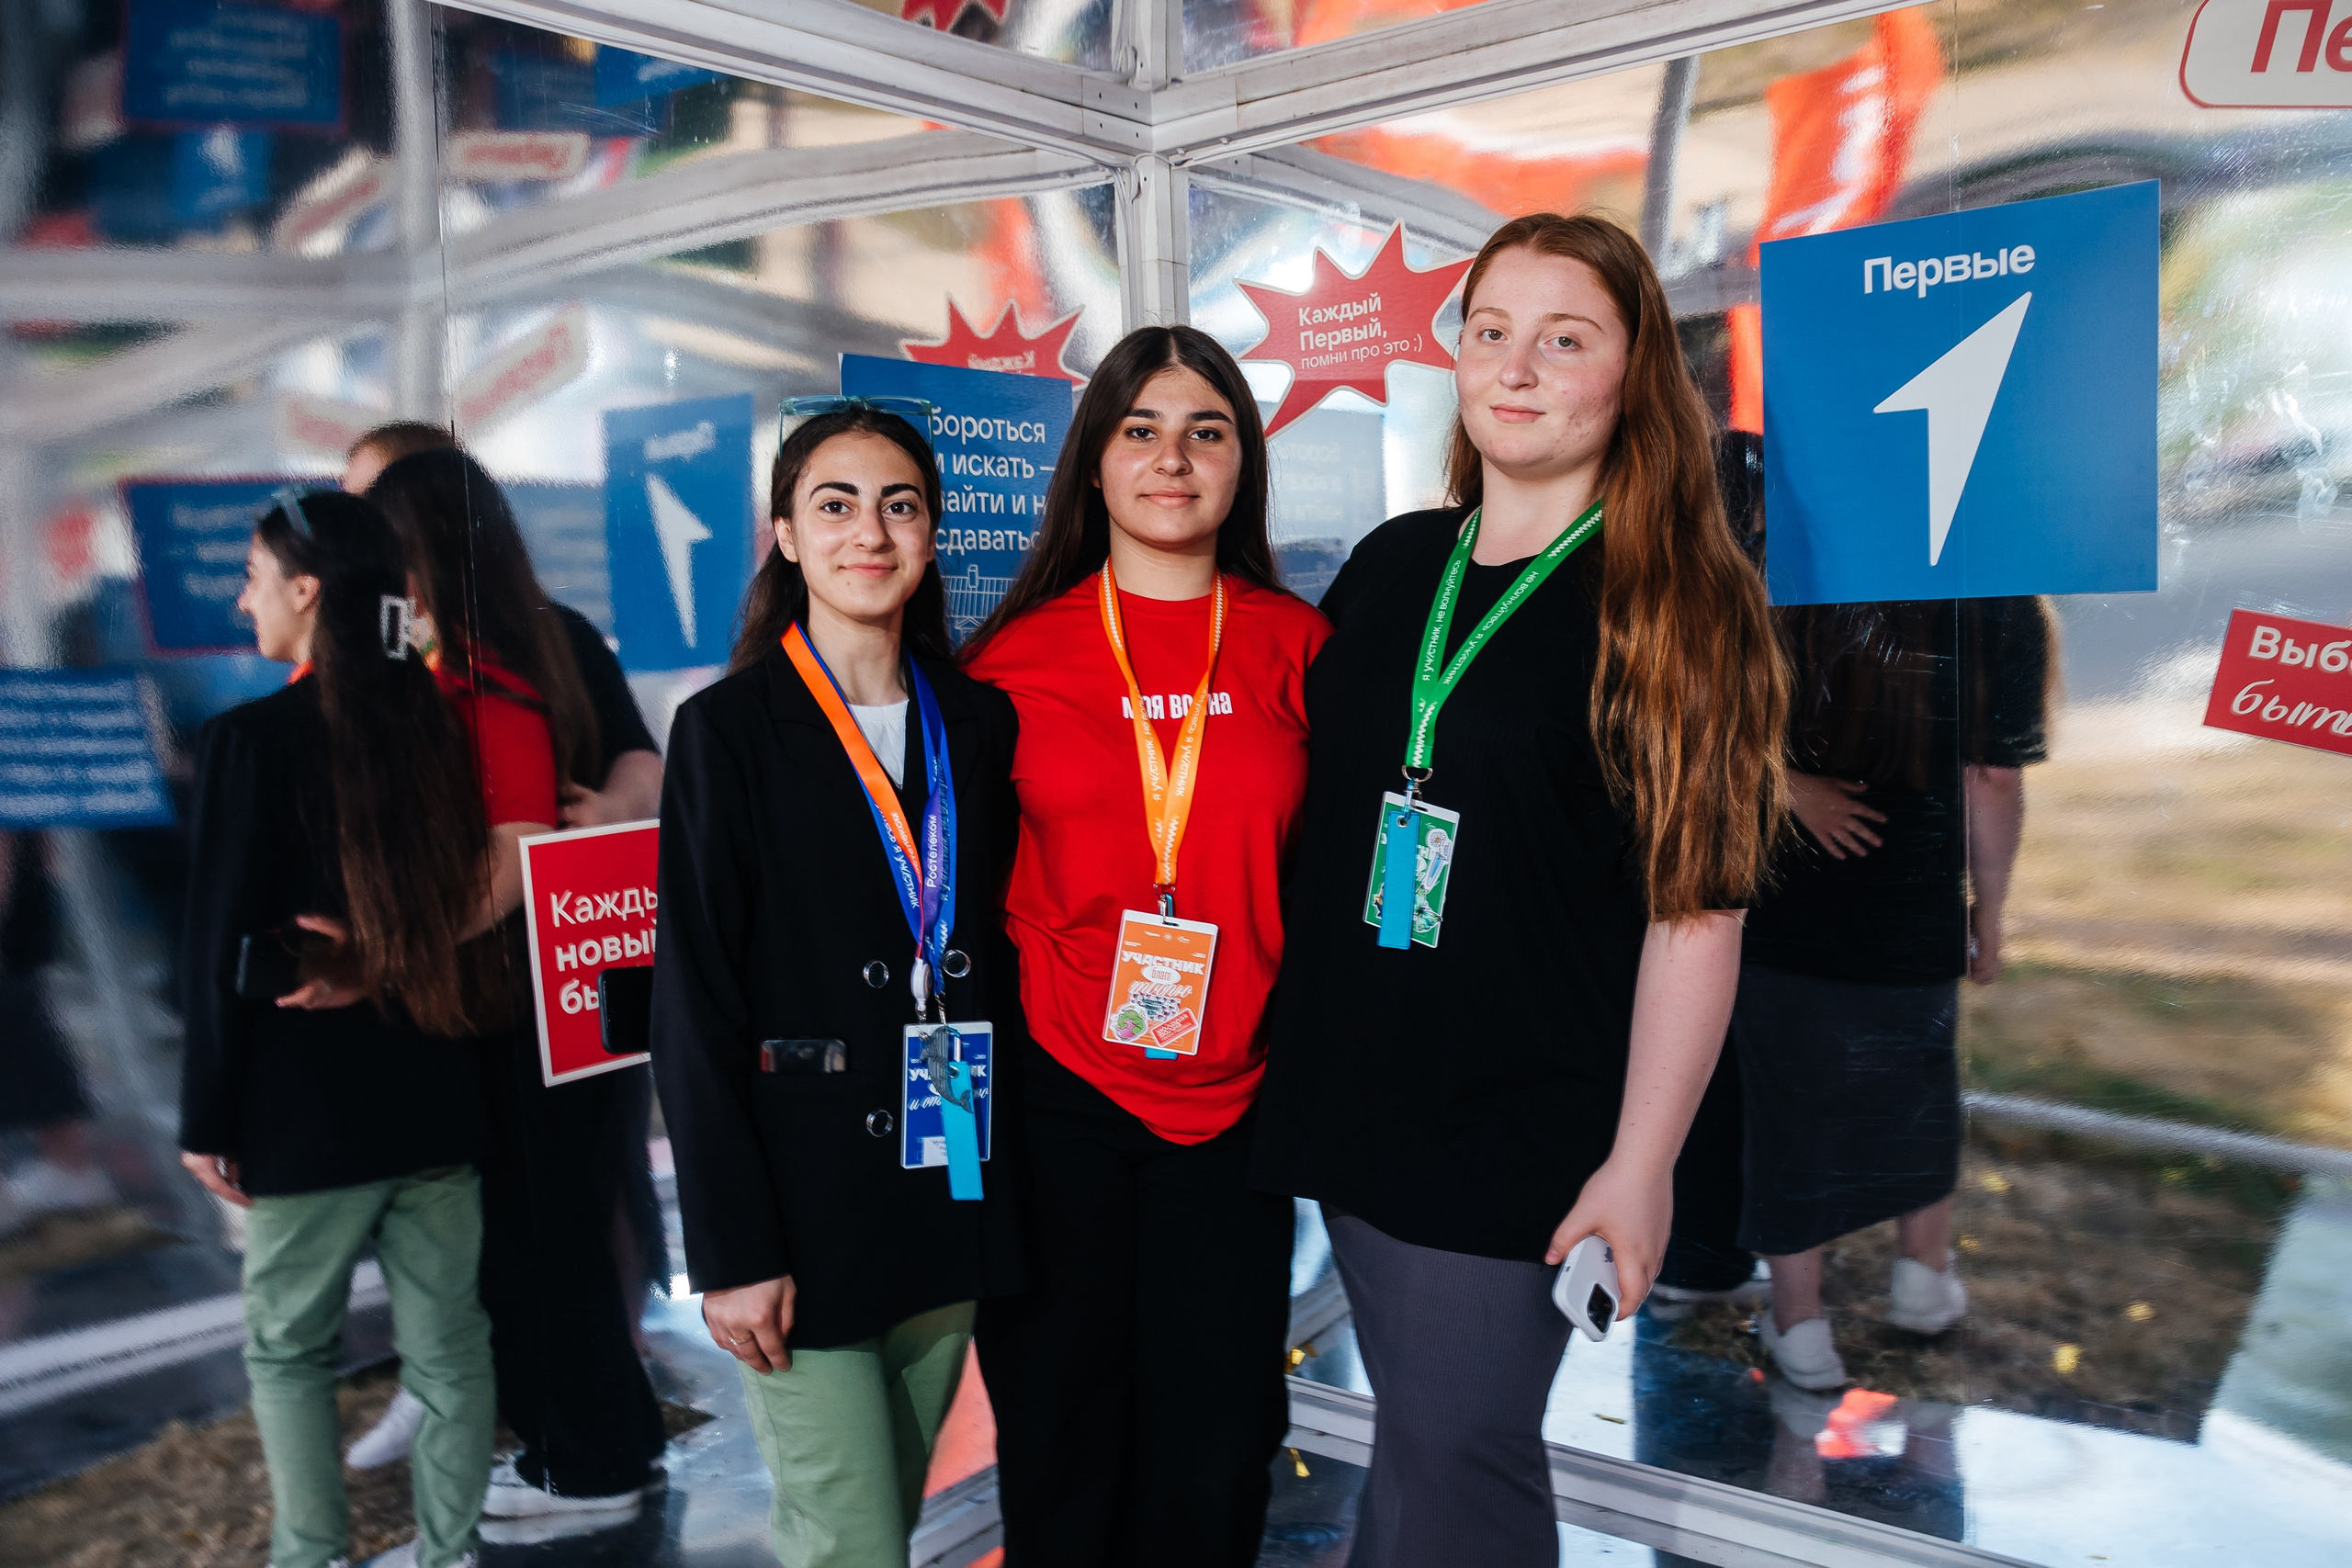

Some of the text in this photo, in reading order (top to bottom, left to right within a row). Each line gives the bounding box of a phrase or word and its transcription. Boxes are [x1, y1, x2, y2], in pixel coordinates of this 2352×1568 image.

[1864, 244, 2035, 299] Первые
[1298, 292, 1382, 327] Каждый
[1300, 317, 1387, 351] Первый,
[1301, 351, 1348, 369] помни
[1351, 344, 1380, 363] про
[1383, 339, 1410, 355] это
[952, 453, 1035, 479] искать
[1012, 494, 1026, 514] и
[935, 528, 1040, 556] сдаватьс
[1439, 559, 1462, 610] волнуйтесь
[1525, 570, 1539, 583] не
[1435, 610, 1445, 623] не
[1482, 582, 1529, 631] волнуйтесь
[2248, 625, 2352, 673] Выб
[927, 814, 938, 888] Ростелеком
[550, 886, 658, 928] Кажды
[1121, 950, 1205, 976] УЧАСТНИК
